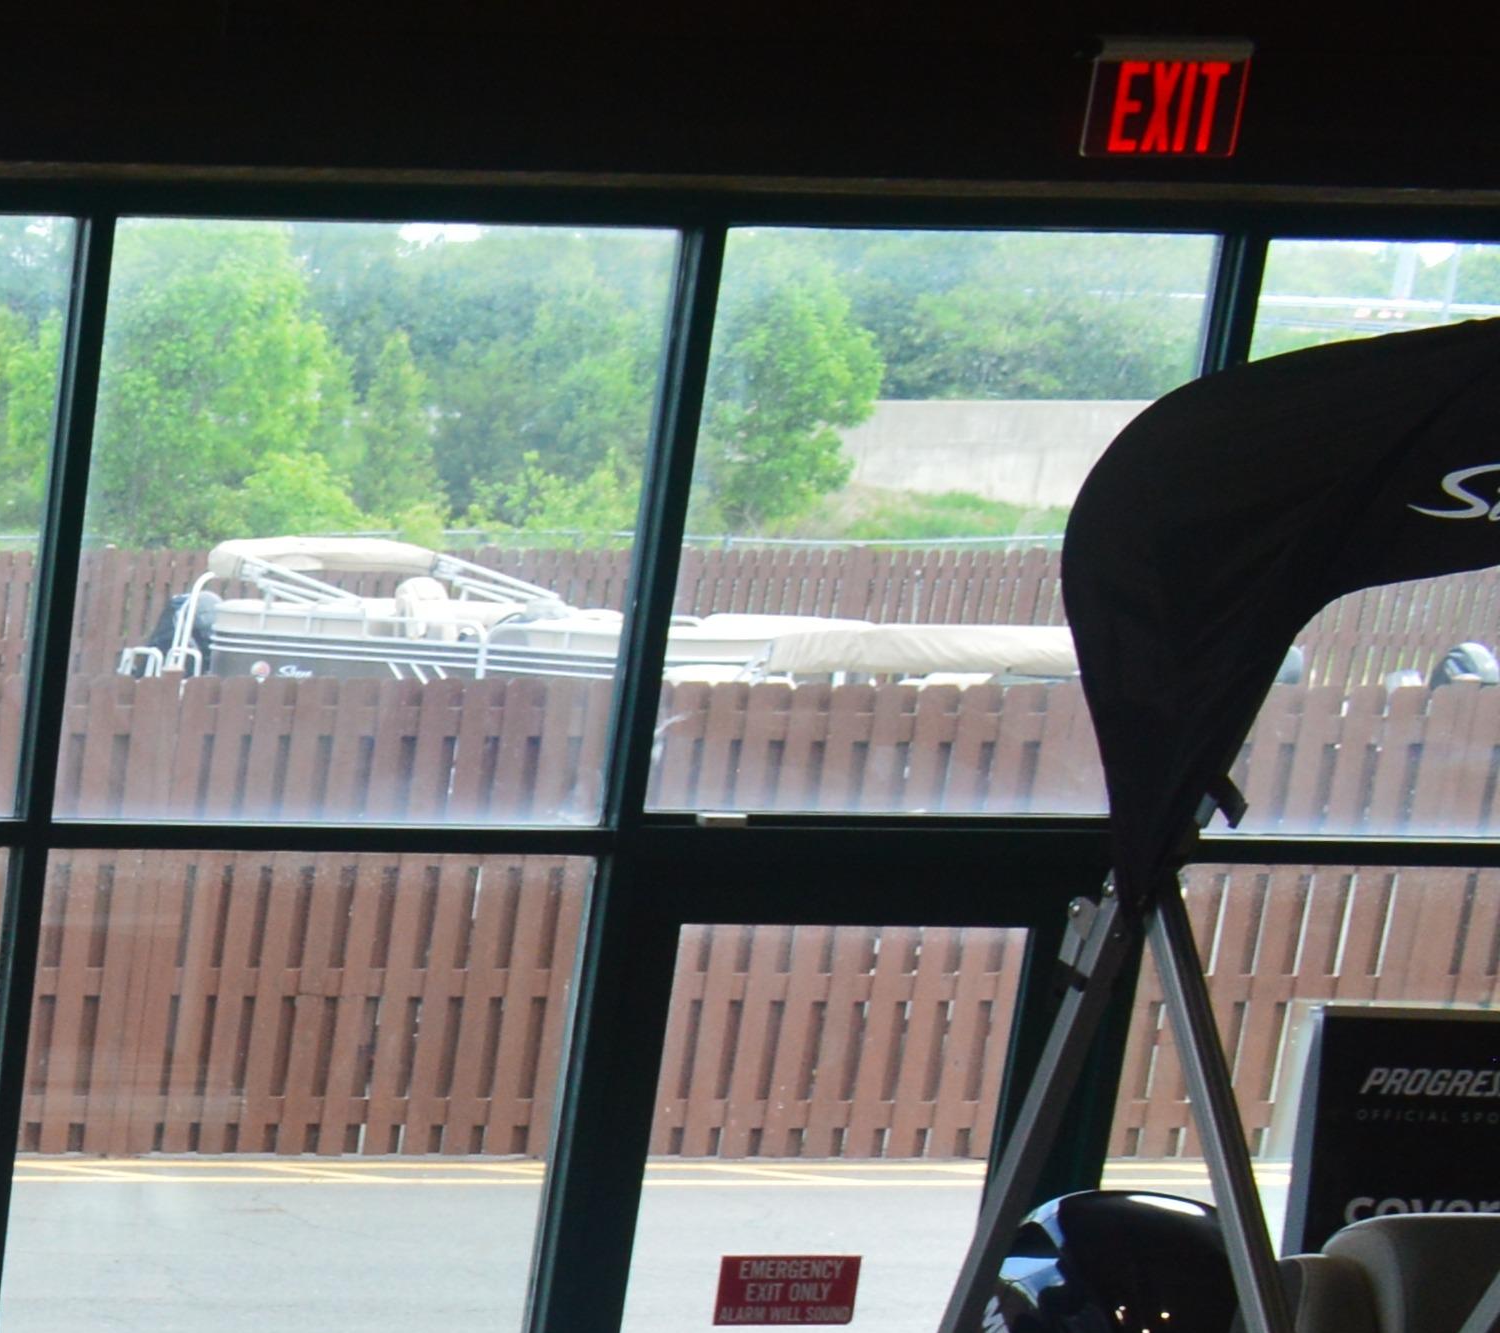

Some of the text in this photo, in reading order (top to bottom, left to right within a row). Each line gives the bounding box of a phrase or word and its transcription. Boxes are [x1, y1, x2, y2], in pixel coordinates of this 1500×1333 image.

[1106, 60, 1232, 154] EXIT
[1356, 1109, 1450, 1123] OFFICIAL
[738, 1260, 845, 1280] EMERGENCY
[745, 1282, 832, 1302] EXIT ONLY
[719, 1306, 851, 1322] ALARM WILL SOUND
